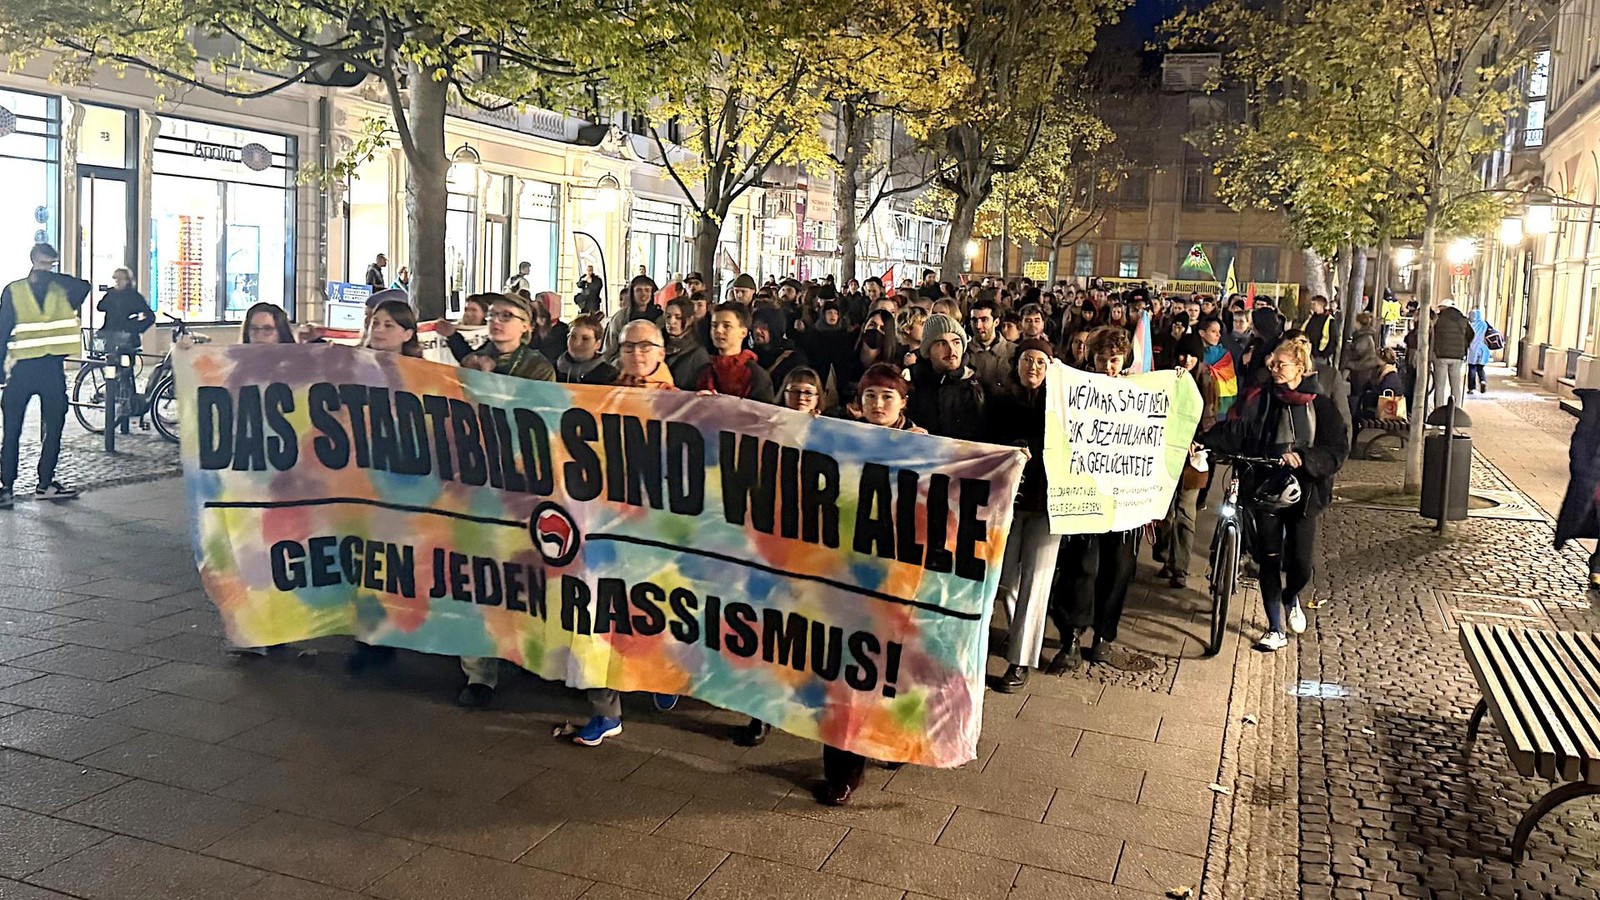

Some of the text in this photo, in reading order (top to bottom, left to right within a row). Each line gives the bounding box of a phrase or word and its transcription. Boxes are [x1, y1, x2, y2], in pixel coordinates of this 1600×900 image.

[1068, 379, 1117, 414] WEIMAR
[1118, 388, 1149, 413] SAGT
[197, 382, 991, 582] DAS STADTBILD SIND WIR ALLE
[1087, 451, 1154, 477] GEFLÜCHTETE
[270, 535, 903, 699] GEGEN JEDEN RASSISMUS!
